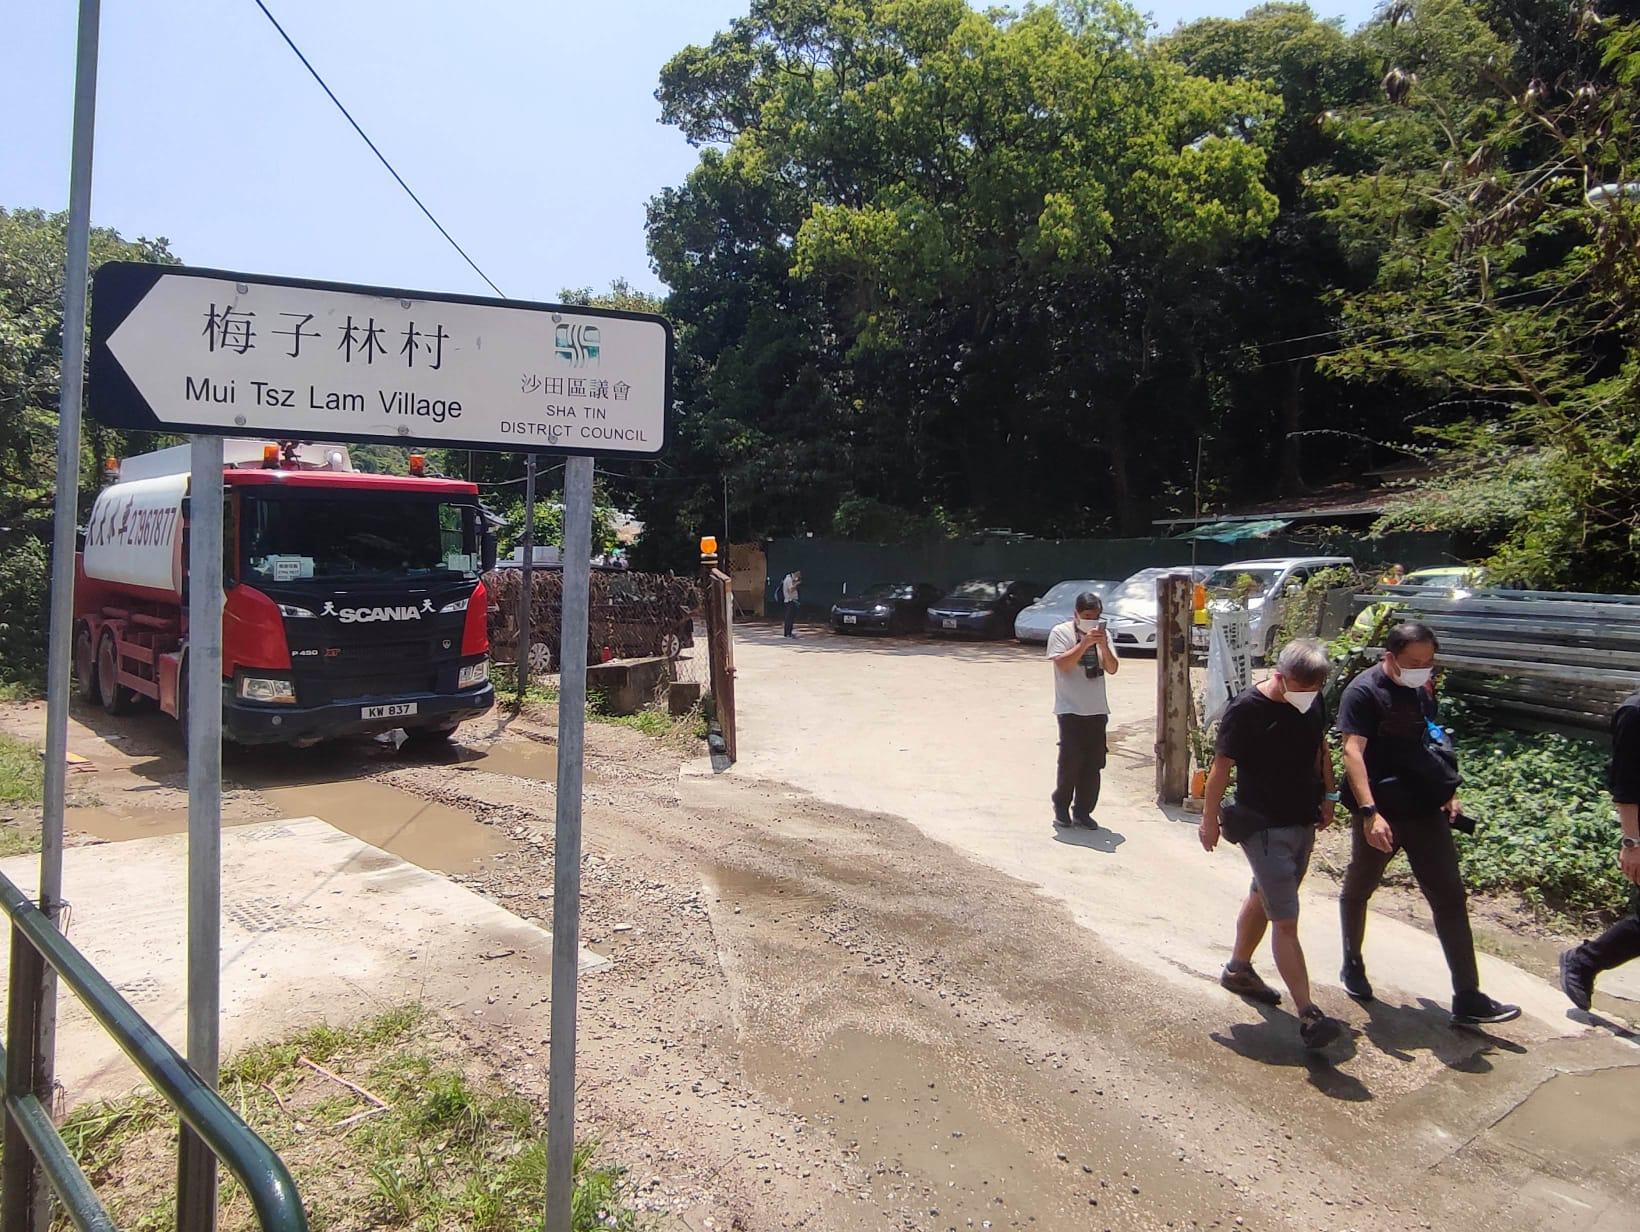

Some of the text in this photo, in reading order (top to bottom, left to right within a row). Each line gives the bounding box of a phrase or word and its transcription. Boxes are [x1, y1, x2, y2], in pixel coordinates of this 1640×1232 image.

[202, 303, 450, 370] 梅子林村
[520, 373, 632, 401] 沙田區議會
[185, 376, 463, 423] Mui Tsz Lam Village
[546, 404, 607, 420] SHA TIN
[500, 421, 648, 442] DISTRICT COUNCIL
[338, 606, 422, 624] SCANIA
[368, 704, 410, 718] KW 837
